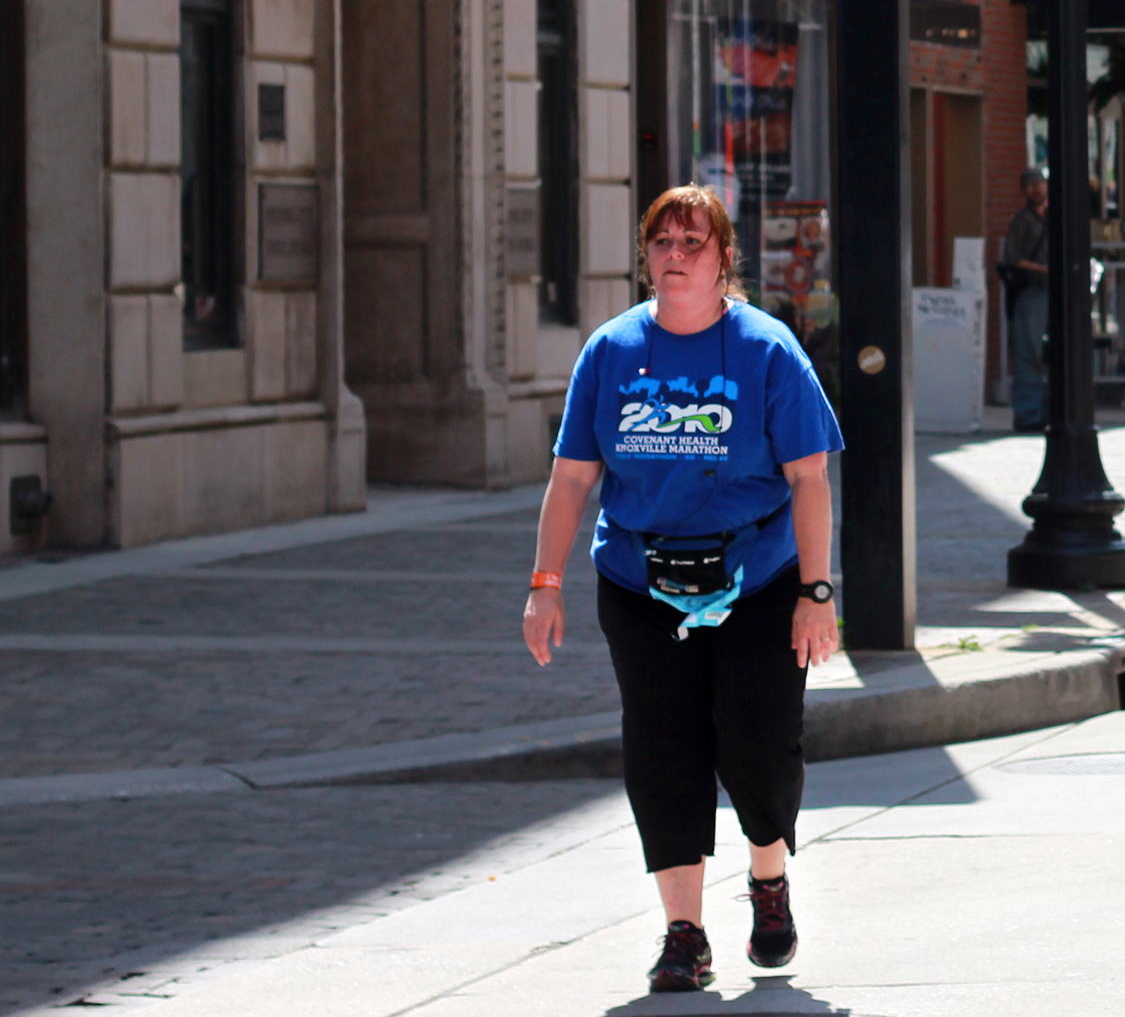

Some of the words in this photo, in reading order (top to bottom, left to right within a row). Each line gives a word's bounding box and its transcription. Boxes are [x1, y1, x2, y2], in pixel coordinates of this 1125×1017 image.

[618, 402, 733, 434] 2010
[623, 435, 677, 444] COVENANT
[678, 436, 719, 446] HEALTH
[615, 443, 667, 453] KNOXVILLE
[668, 445, 728, 455] MARATHON
